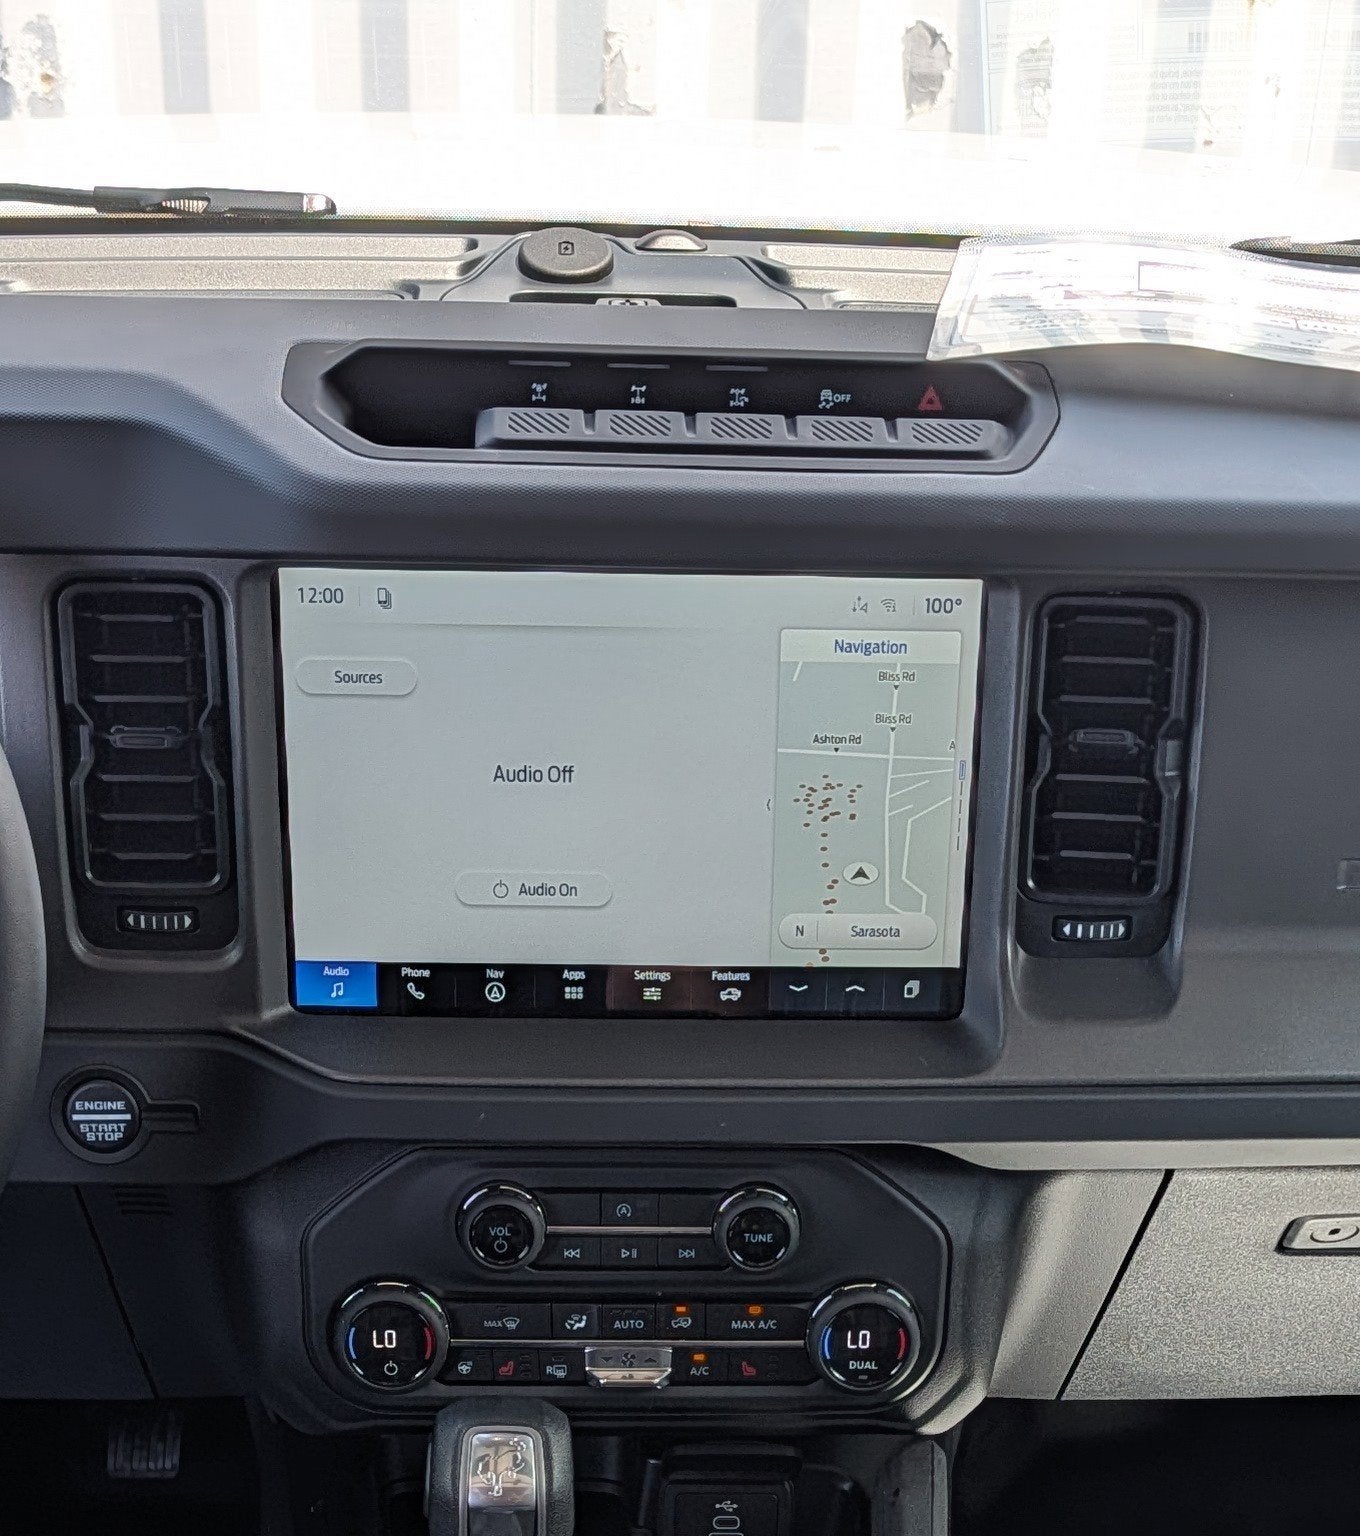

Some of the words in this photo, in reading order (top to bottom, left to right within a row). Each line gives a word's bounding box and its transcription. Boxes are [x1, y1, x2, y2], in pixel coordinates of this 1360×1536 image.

[833, 394, 852, 403] OFF
[297, 587, 344, 605] 12:00
[834, 639, 908, 656] Navigation
[334, 670, 384, 685] Sources
[878, 670, 900, 683] Bliss
[902, 671, 916, 682] Rd
[875, 713, 897, 725] Bliss
[898, 713, 912, 725] Rd
[812, 733, 846, 745] Ashton
[848, 733, 862, 745] Rd
[493, 764, 543, 783] Audio
[548, 765, 575, 784] Off
[518, 882, 557, 897] Audio
[559, 883, 578, 897] On
[795, 925, 805, 937] N
[850, 925, 900, 938] Sarasota
[323, 966, 349, 978] Audio
[401, 966, 430, 978] Phone
[486, 968, 505, 980] Nav
[562, 968, 586, 981] Apps
[634, 970, 671, 982] Settings
[711, 970, 750, 981] Features
[75, 1101, 127, 1111] ENGINE
[80, 1123, 127, 1133] START
[86, 1132, 124, 1142] STOP
[489, 1226, 512, 1237] VOL
[744, 1233, 774, 1244] TUNE
[483, 1320, 502, 1329] MAX
[613, 1319, 644, 1330] AUTO
[731, 1320, 756, 1330] MAX
[758, 1319, 778, 1330] A/C
[372, 1329, 397, 1349] LO
[846, 1330, 871, 1349] LO
[690, 1366, 710, 1376] A/C
[848, 1360, 878, 1370] DUAL
